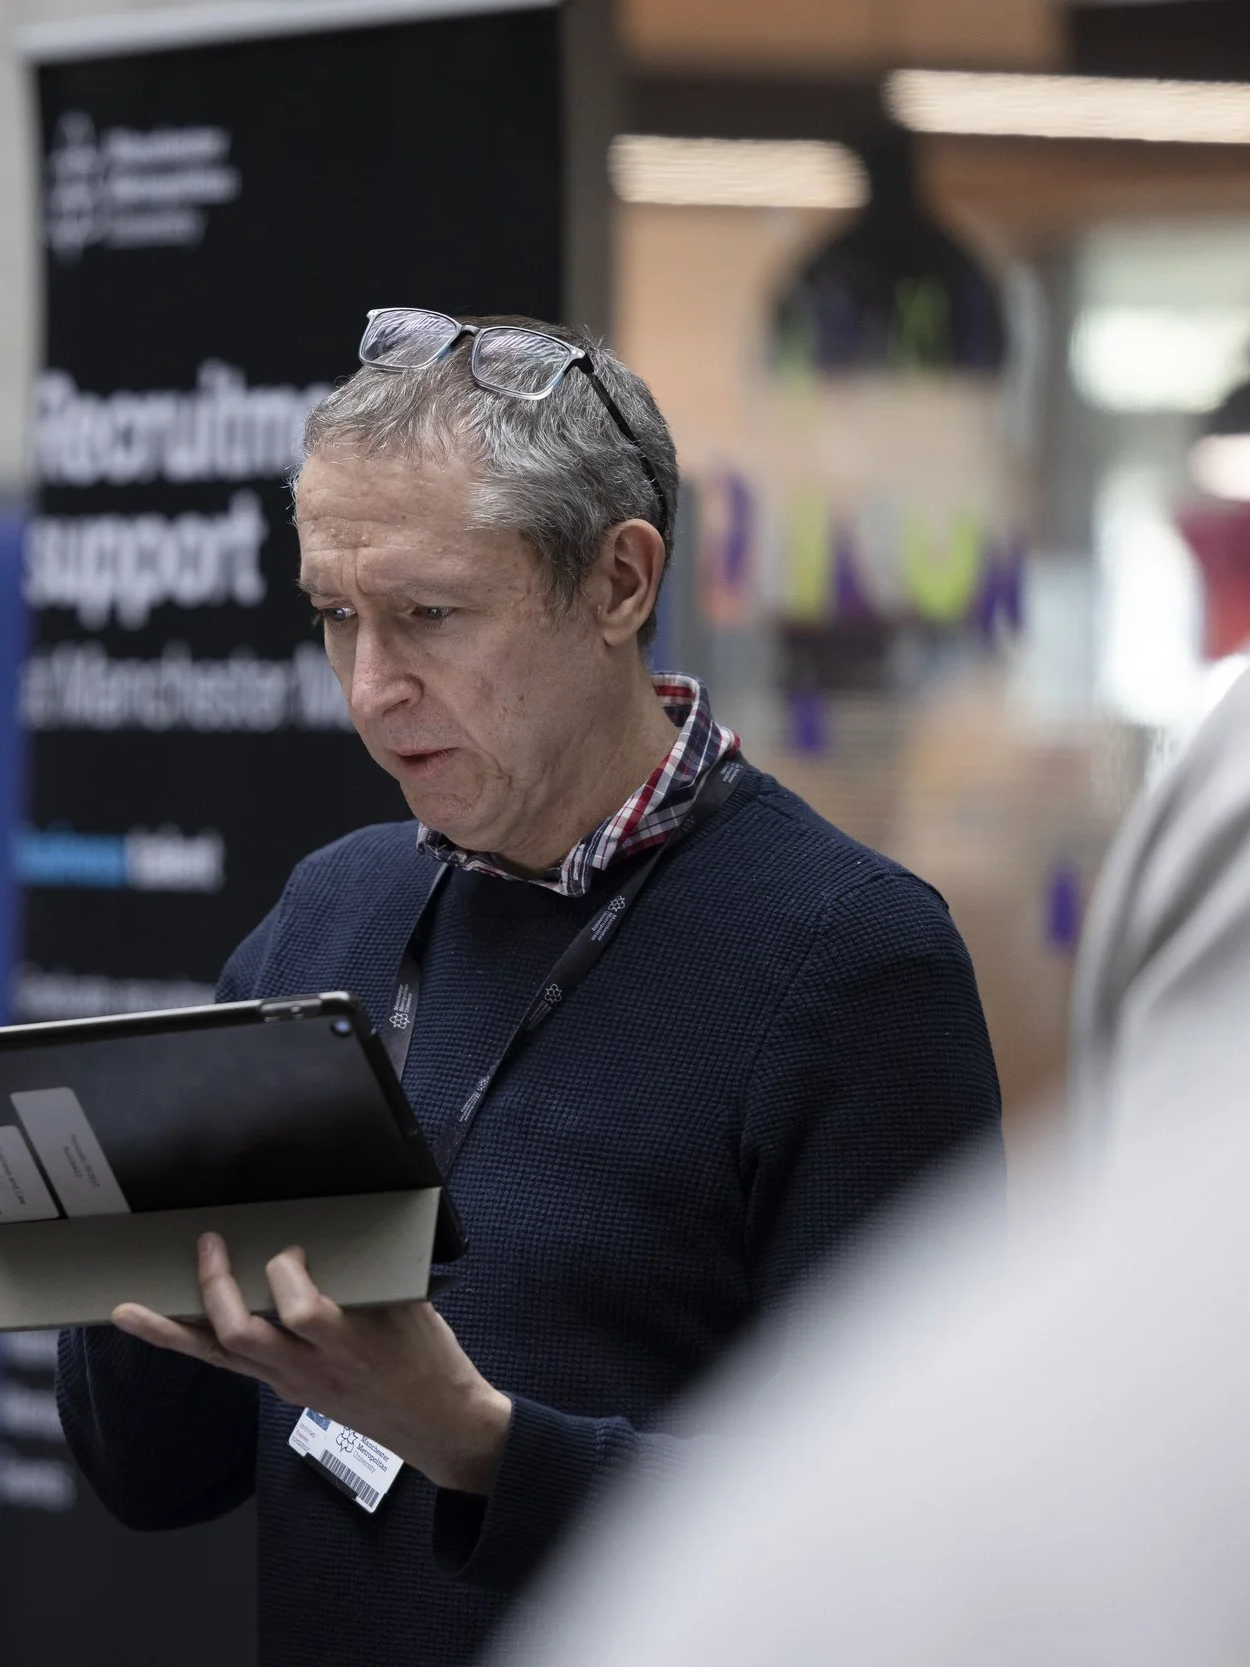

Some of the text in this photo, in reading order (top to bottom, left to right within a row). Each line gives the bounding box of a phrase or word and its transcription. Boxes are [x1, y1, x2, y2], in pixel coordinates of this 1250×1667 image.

[23, 492, 265, 628] support
[55, 641, 285, 731] Manchester
[352, 1450, 376, 1473] University
[355, 1443, 388, 1472] Metropolitan
[360, 1435, 390, 1461] Manchester
